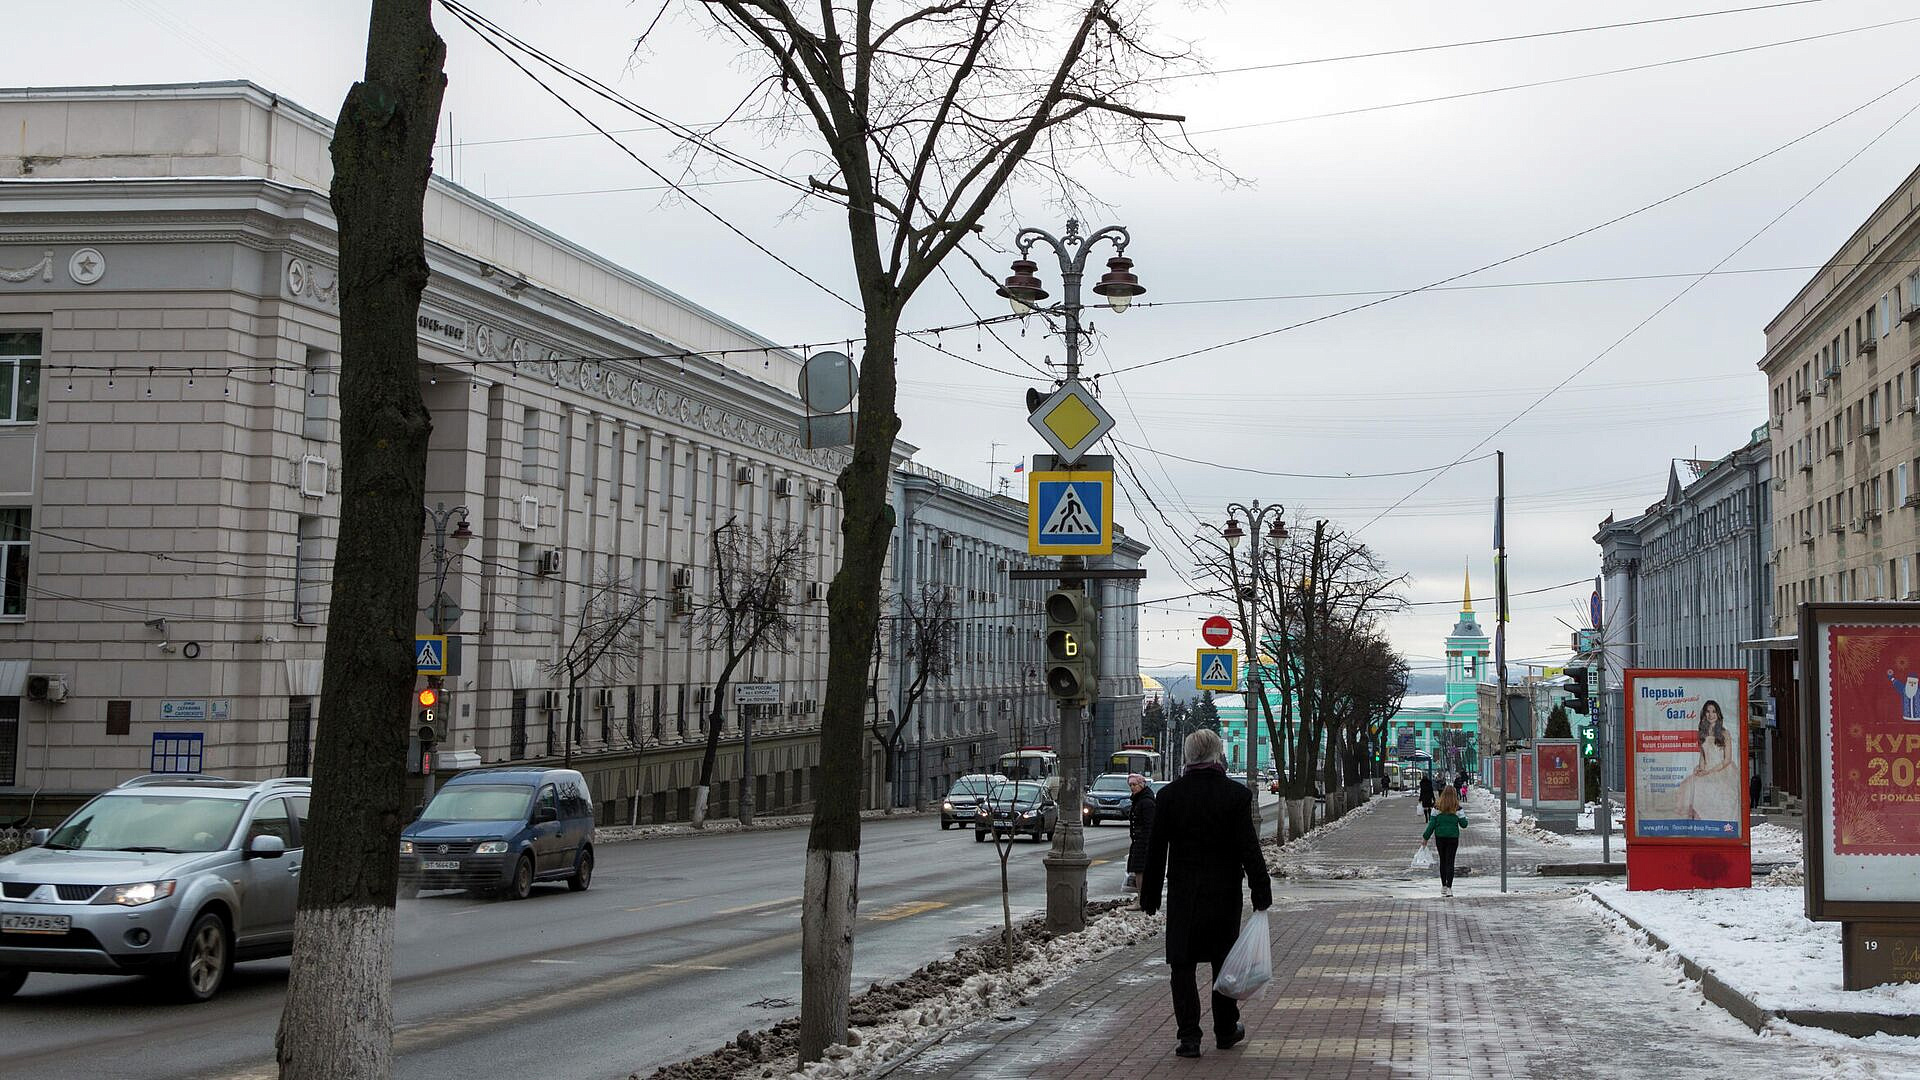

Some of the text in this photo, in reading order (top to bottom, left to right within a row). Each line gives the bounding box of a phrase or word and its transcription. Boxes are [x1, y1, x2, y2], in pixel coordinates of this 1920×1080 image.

[1066, 633, 1077, 656] 6
[1641, 686, 1684, 701] Первый
[426, 709, 433, 721] 6
[1583, 728, 1594, 739] 46
[1868, 757, 1920, 787] 20
[1547, 776, 1570, 784] 2020
[1870, 793, 1877, 802] С
[1864, 941, 1878, 950] 19
